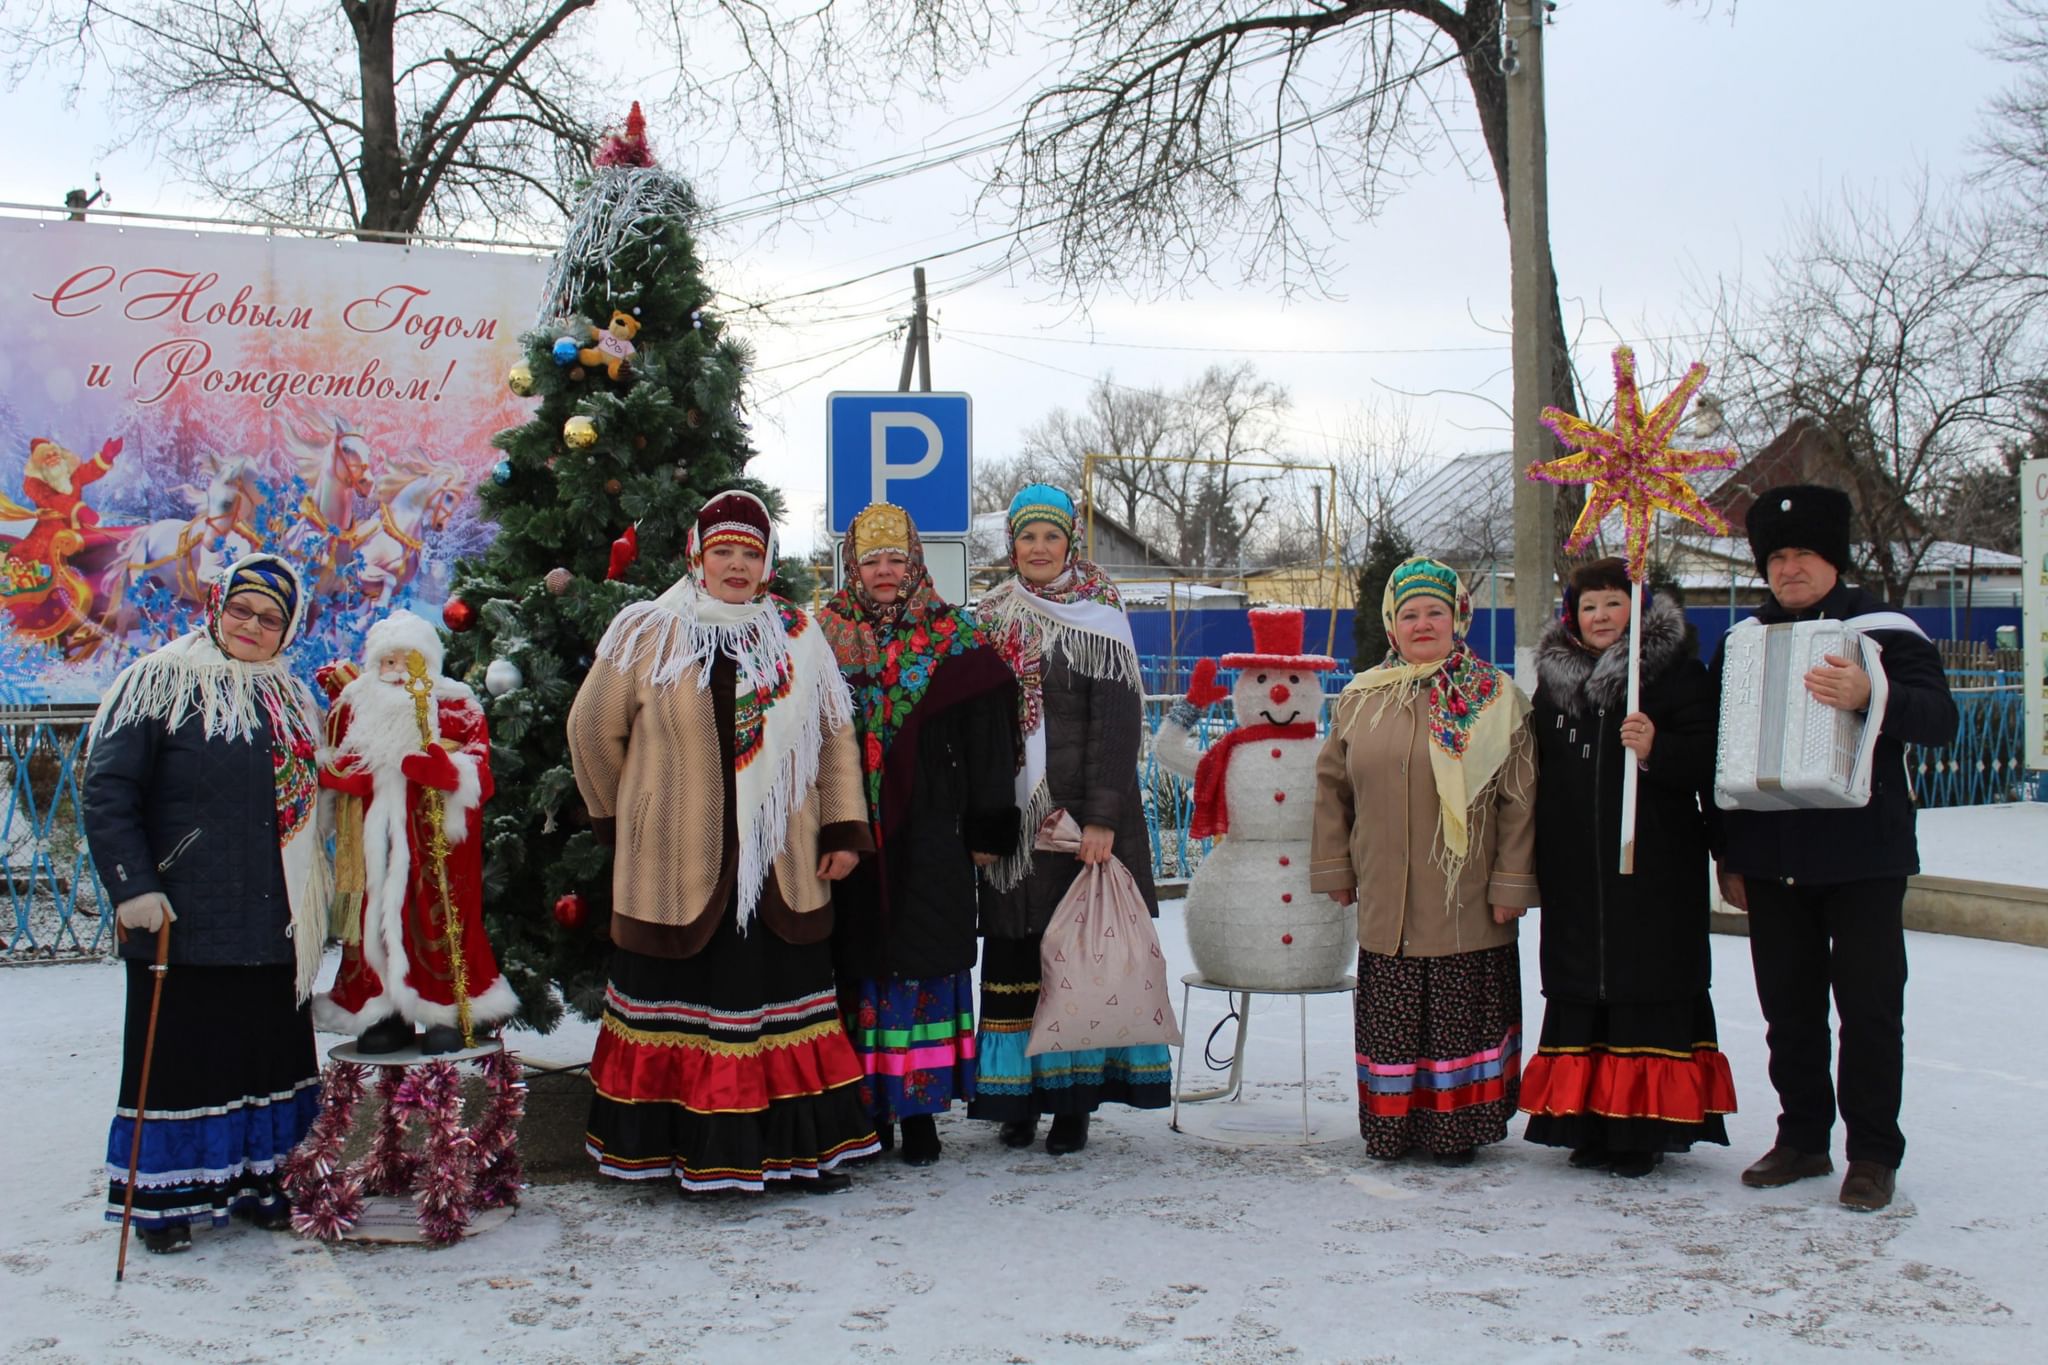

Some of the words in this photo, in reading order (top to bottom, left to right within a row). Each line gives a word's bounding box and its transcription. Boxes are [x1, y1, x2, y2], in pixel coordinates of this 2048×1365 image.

[33, 266, 116, 317] С
[119, 268, 312, 330] Новым
[343, 284, 498, 351] Годом
[86, 362, 112, 389] и
[133, 338, 457, 409] Рождеством!
[870, 411, 944, 504] P
